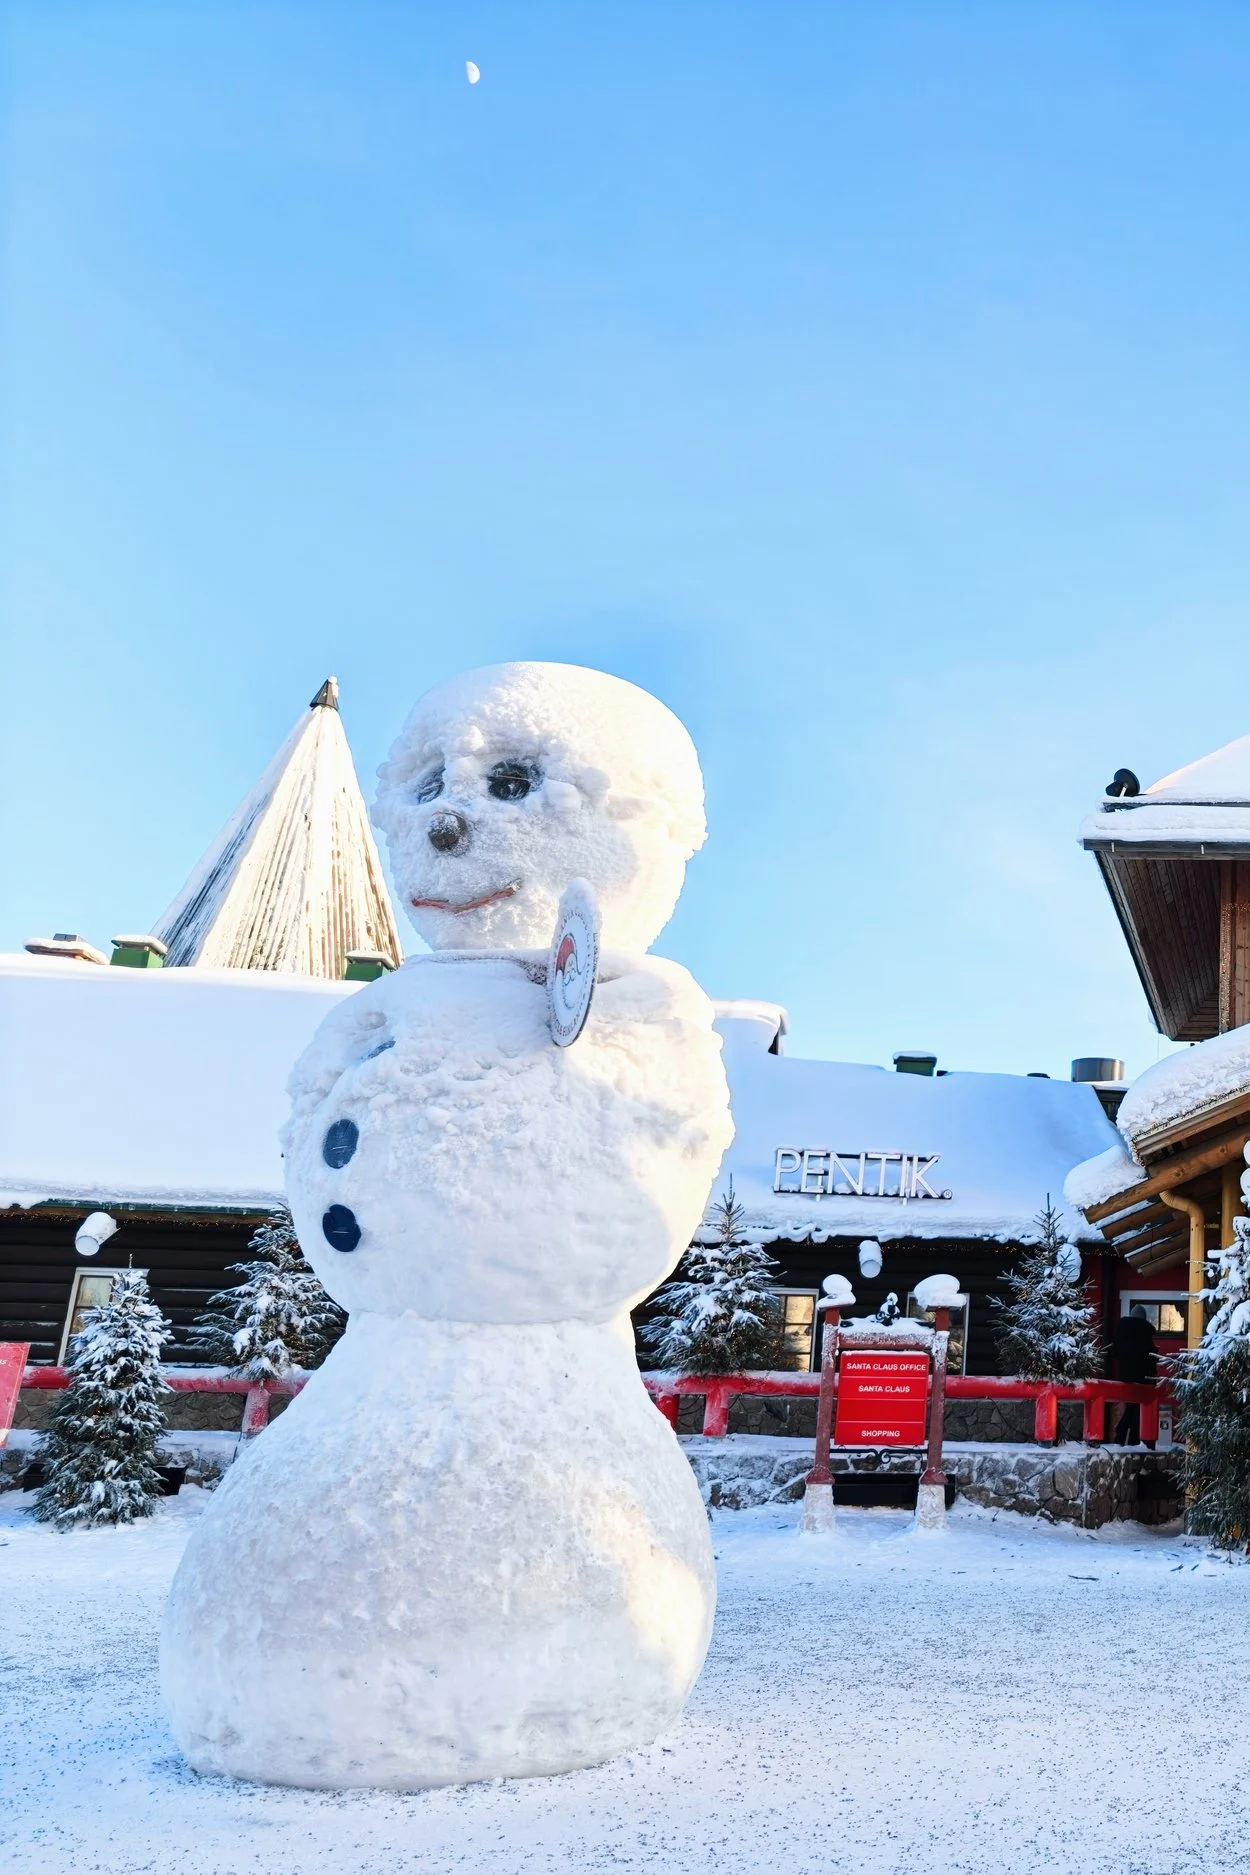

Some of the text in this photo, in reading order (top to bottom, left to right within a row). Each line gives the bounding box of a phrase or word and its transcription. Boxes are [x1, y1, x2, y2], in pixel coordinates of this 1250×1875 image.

[846, 1362, 927, 1371] SANTA CLAUS OFFICE
[884, 1385, 910, 1393] CLAUS
[861, 1430, 900, 1438] SHOPPING
